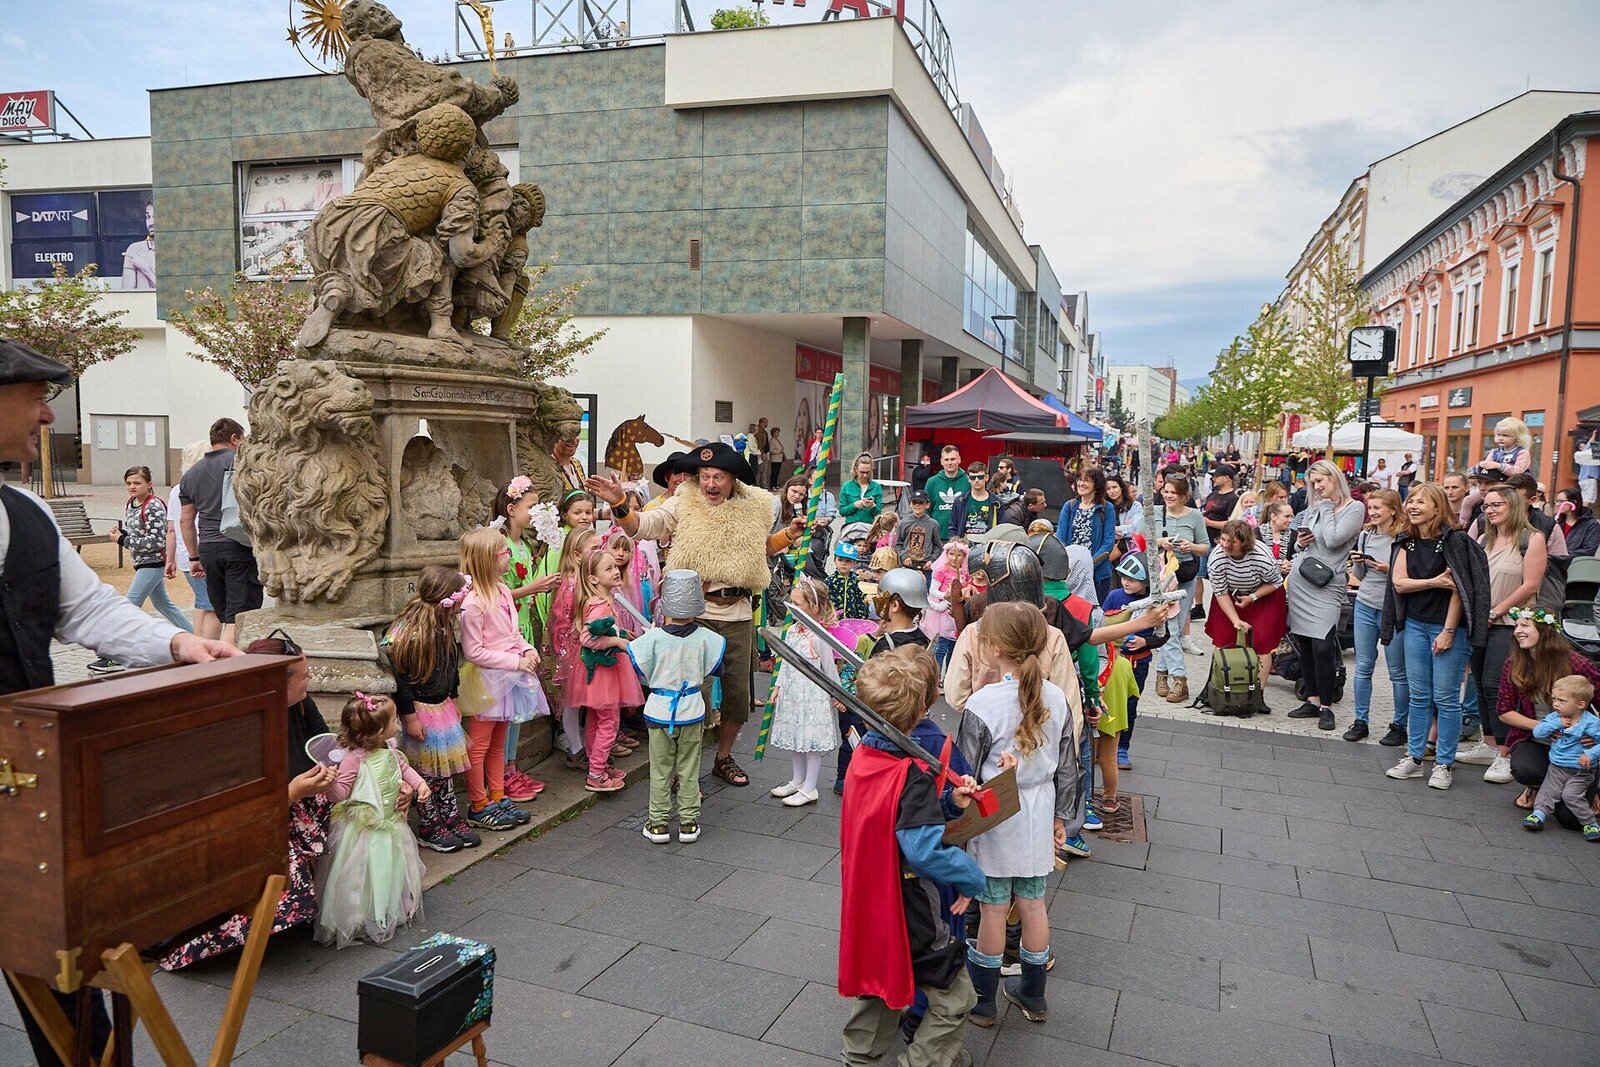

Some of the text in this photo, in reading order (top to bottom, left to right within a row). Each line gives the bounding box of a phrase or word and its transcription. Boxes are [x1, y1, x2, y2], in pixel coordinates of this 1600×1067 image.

[2, 100, 35, 119] MAY
[2, 116, 26, 126] DISCO
[32, 210, 73, 222] DATART
[35, 252, 74, 262] ELEKTRO
[408, 582, 416, 593] R
